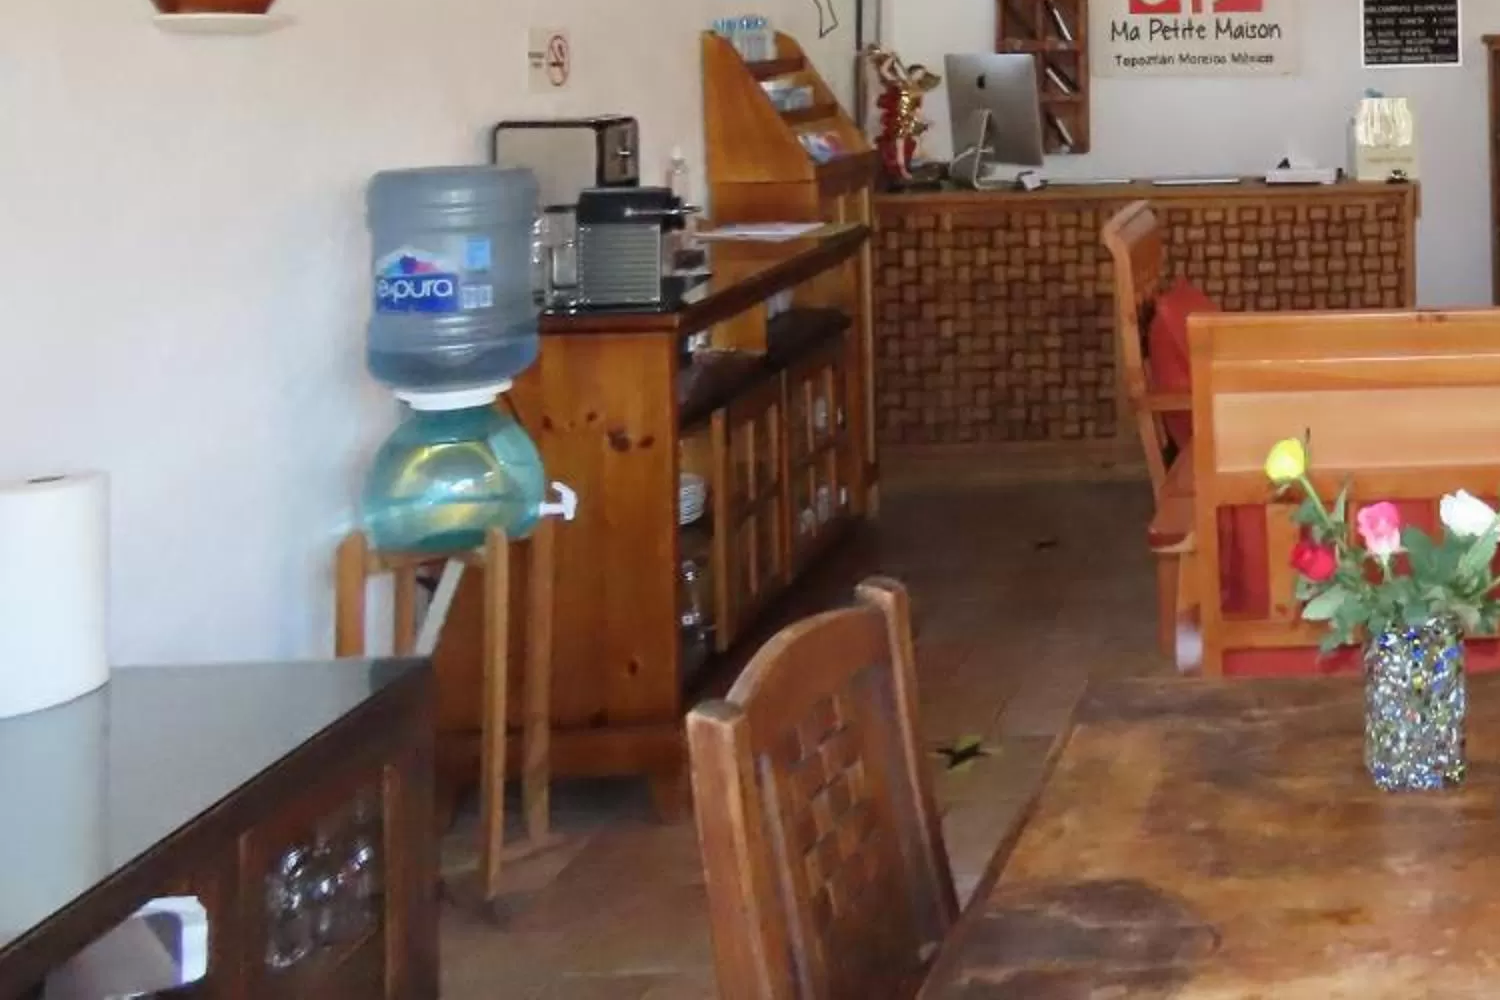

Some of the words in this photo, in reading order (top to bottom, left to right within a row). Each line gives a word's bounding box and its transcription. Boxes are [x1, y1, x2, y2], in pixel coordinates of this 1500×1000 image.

[1111, 19, 1141, 42] Ma
[1149, 17, 1207, 42] Petite
[1215, 16, 1281, 42] Maison
